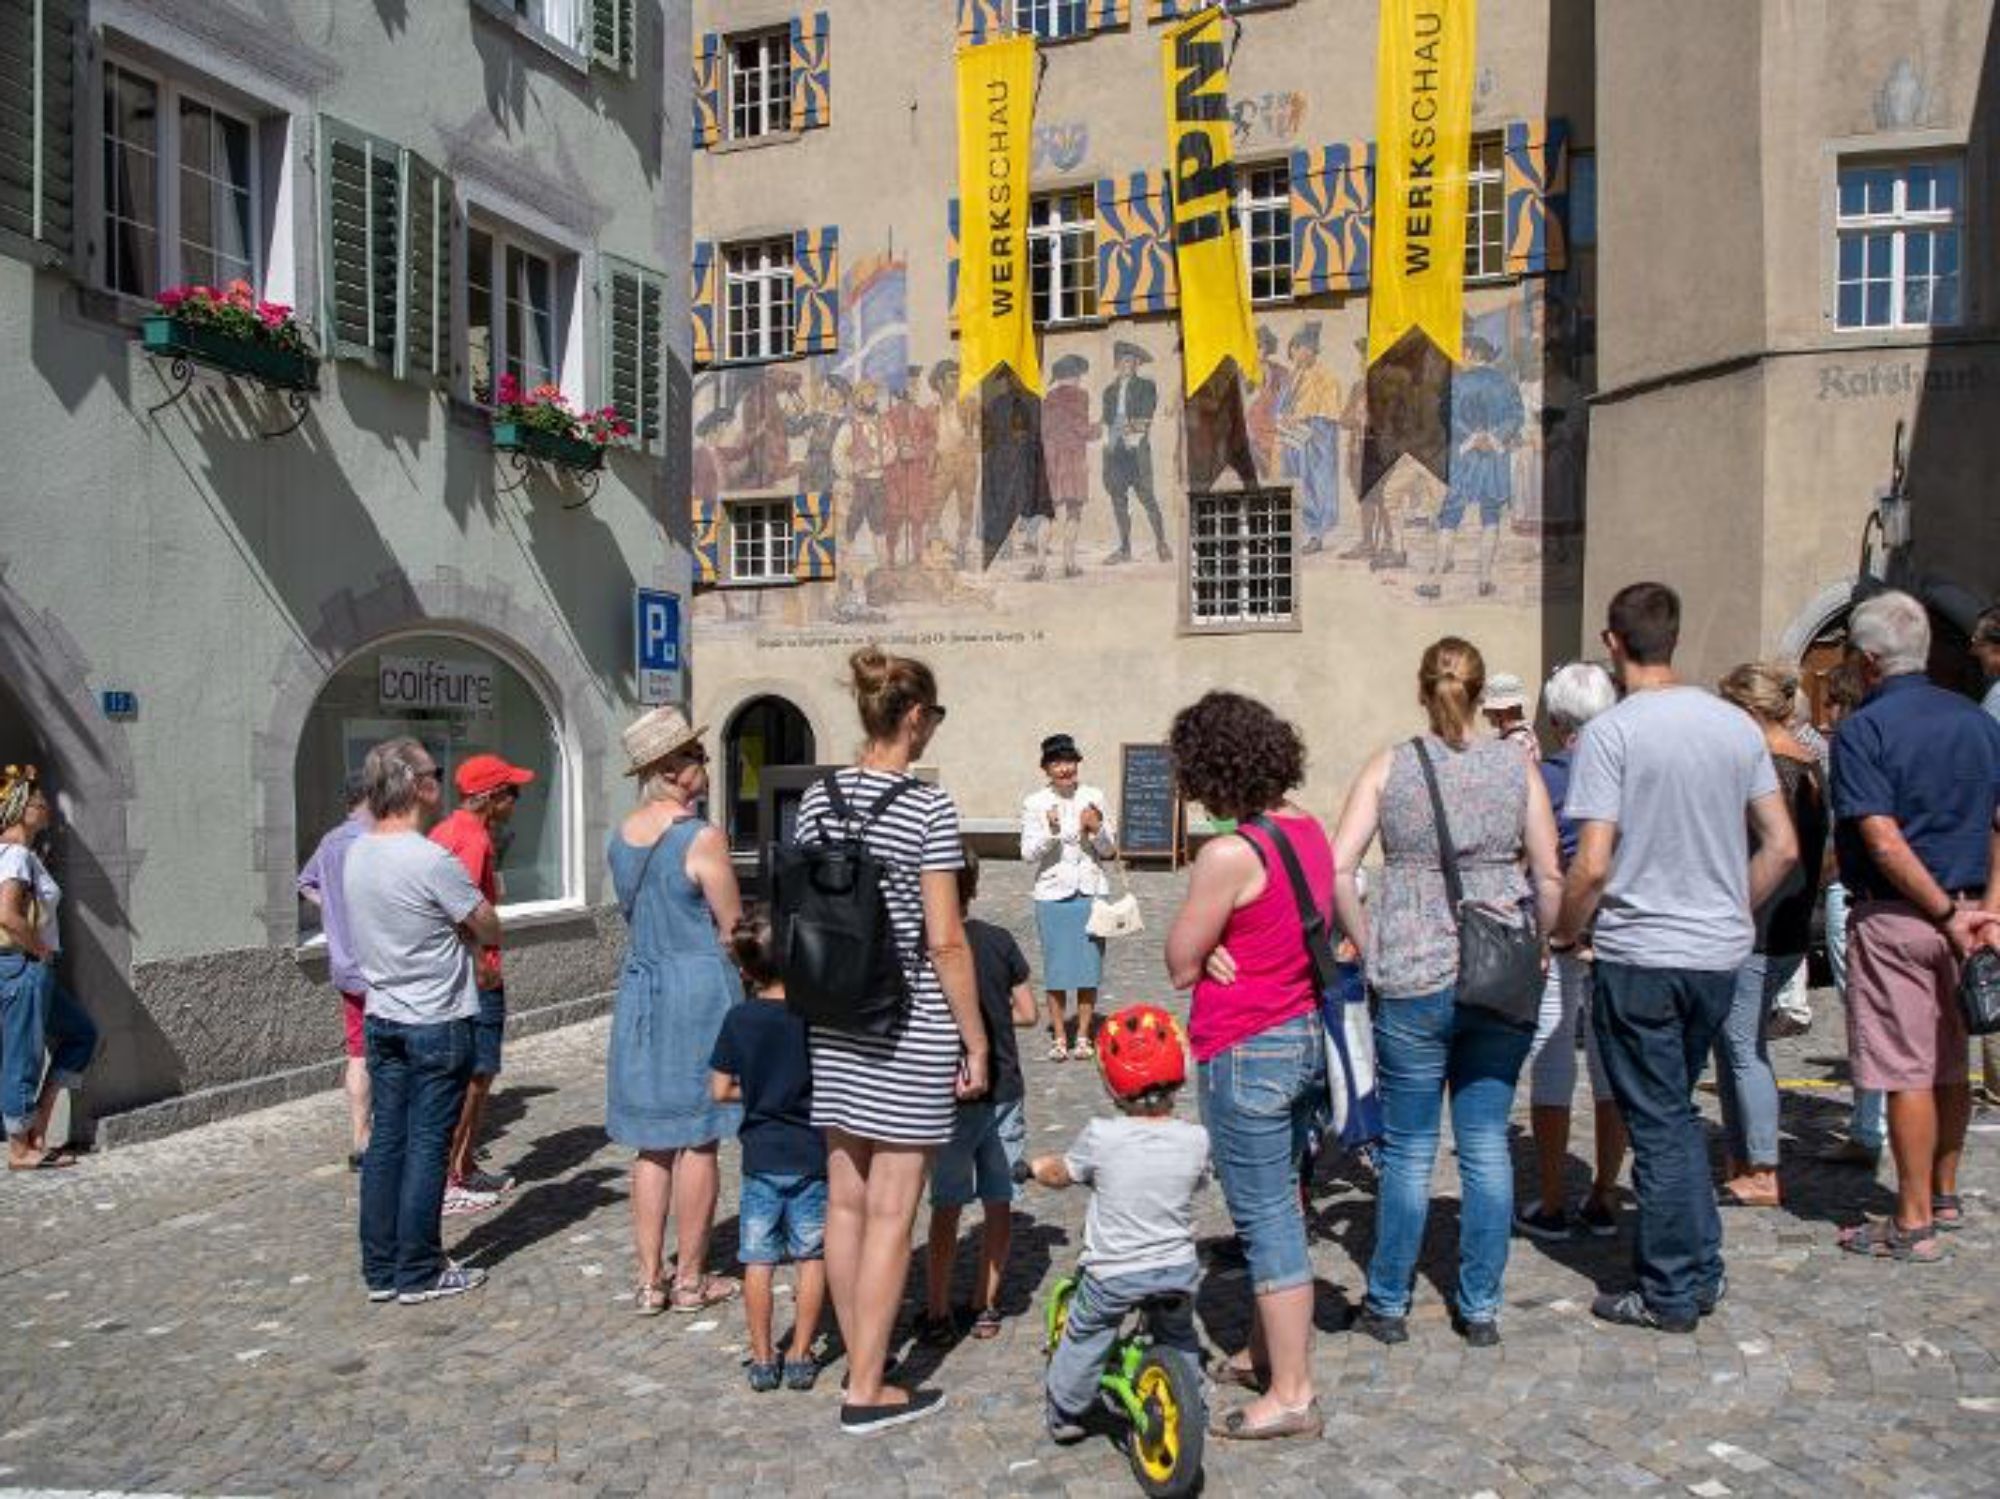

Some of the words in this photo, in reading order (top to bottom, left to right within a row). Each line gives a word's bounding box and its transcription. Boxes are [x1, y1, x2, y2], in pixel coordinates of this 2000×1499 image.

[986, 80, 1013, 318] WERKSCHAU
[1404, 12, 1441, 276] WERKSCHAU
[381, 658, 491, 705] coiffure
[646, 602, 667, 658] P
